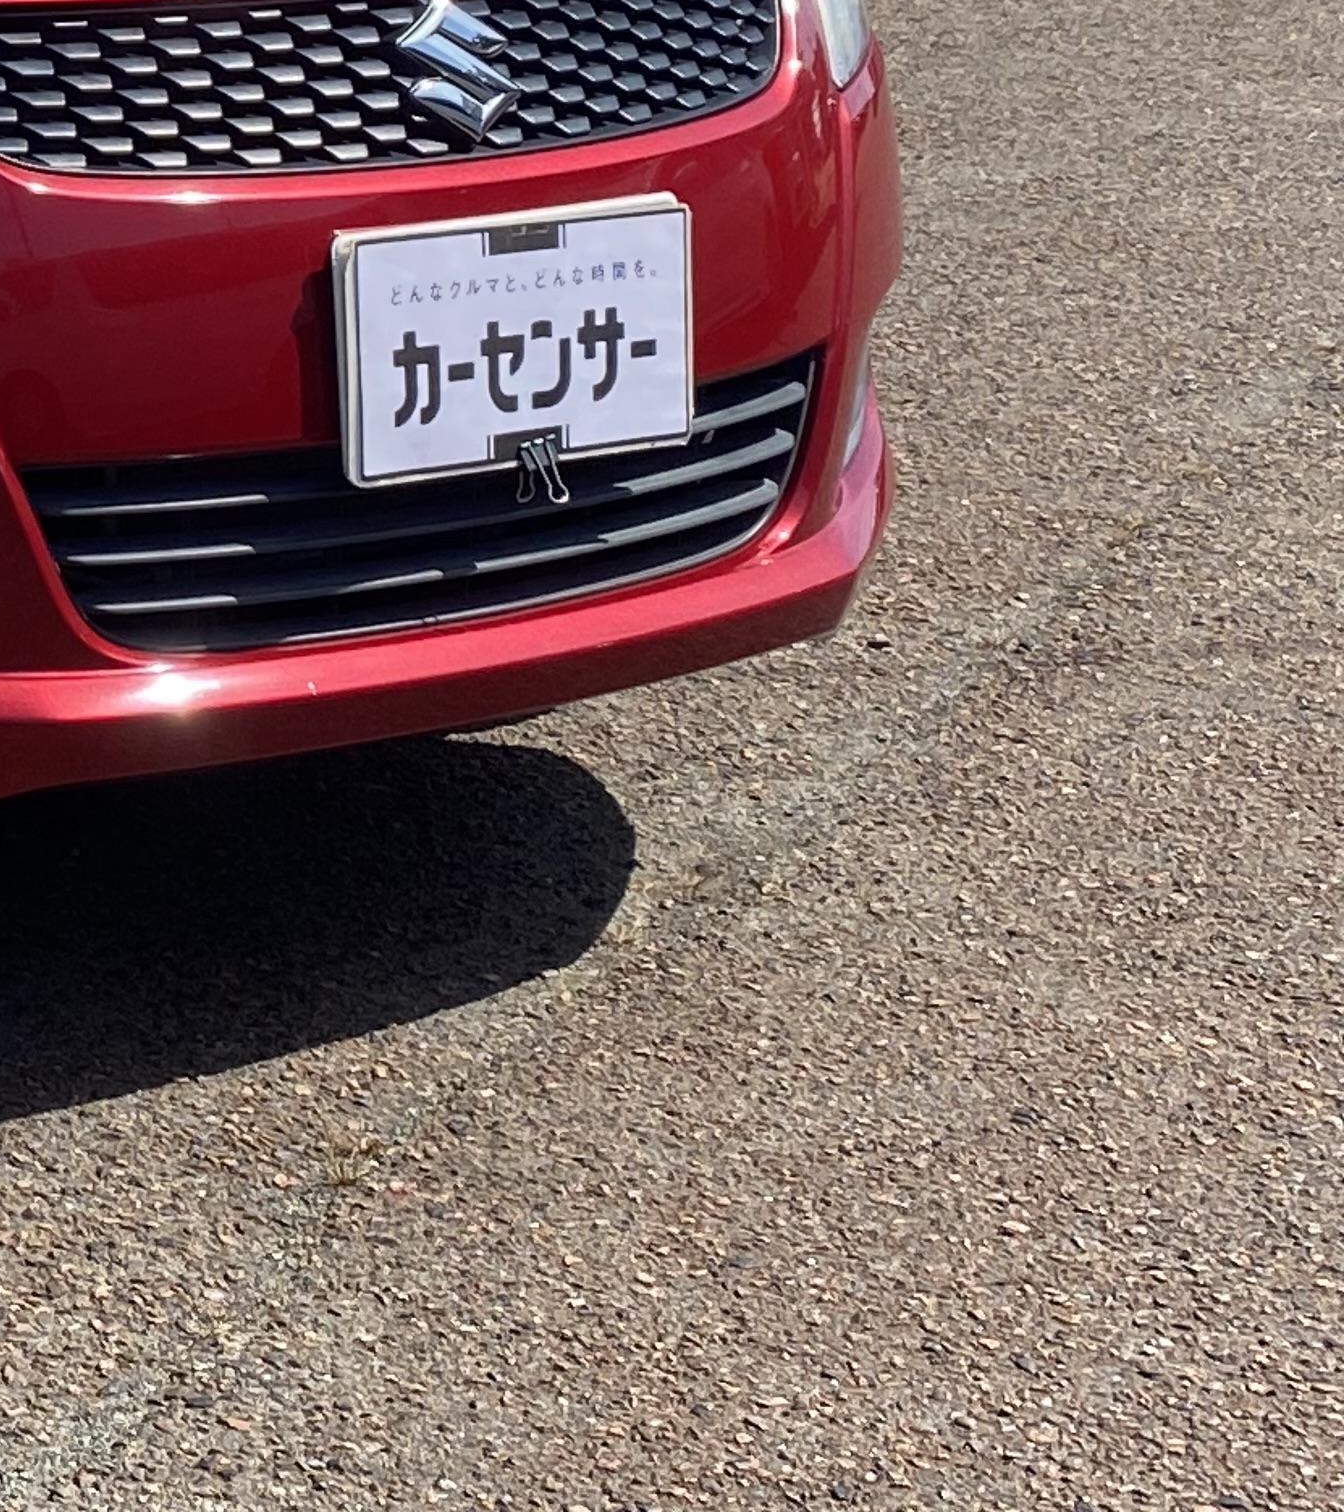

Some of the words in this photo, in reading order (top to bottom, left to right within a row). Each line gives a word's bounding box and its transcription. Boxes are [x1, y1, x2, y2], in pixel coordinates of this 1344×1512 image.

[392, 306, 658, 428] カーセンサー
